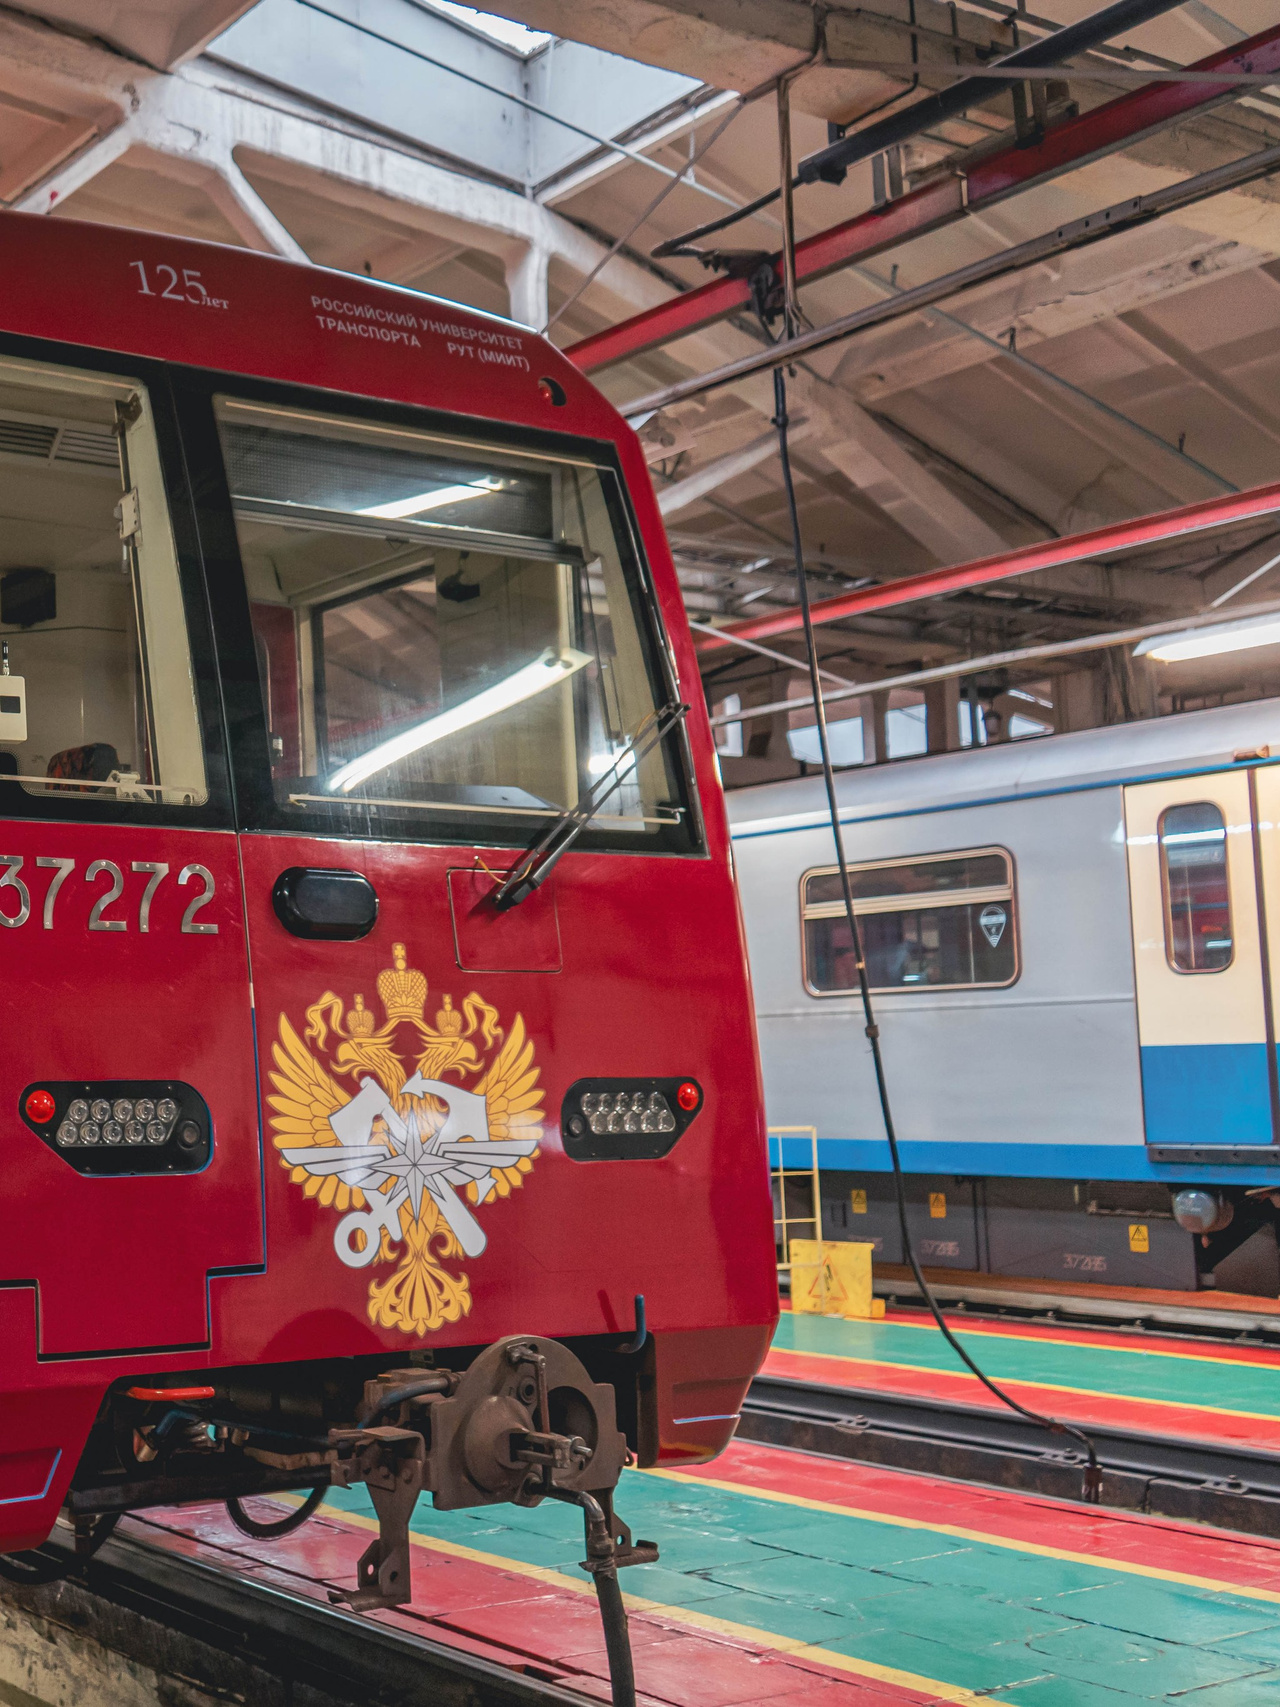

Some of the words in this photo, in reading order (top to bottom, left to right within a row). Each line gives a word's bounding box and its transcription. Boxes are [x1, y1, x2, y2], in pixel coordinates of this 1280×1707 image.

[129, 260, 207, 305] 125
[201, 296, 229, 310] лет
[311, 295, 418, 329] РОССИЙСКИЙ
[419, 317, 523, 350] УНИВЕРСИТЕТ
[316, 315, 422, 348] ТРАНСПОРТА
[447, 342, 474, 359] РУТ
[478, 348, 530, 373] (МИИТ)
